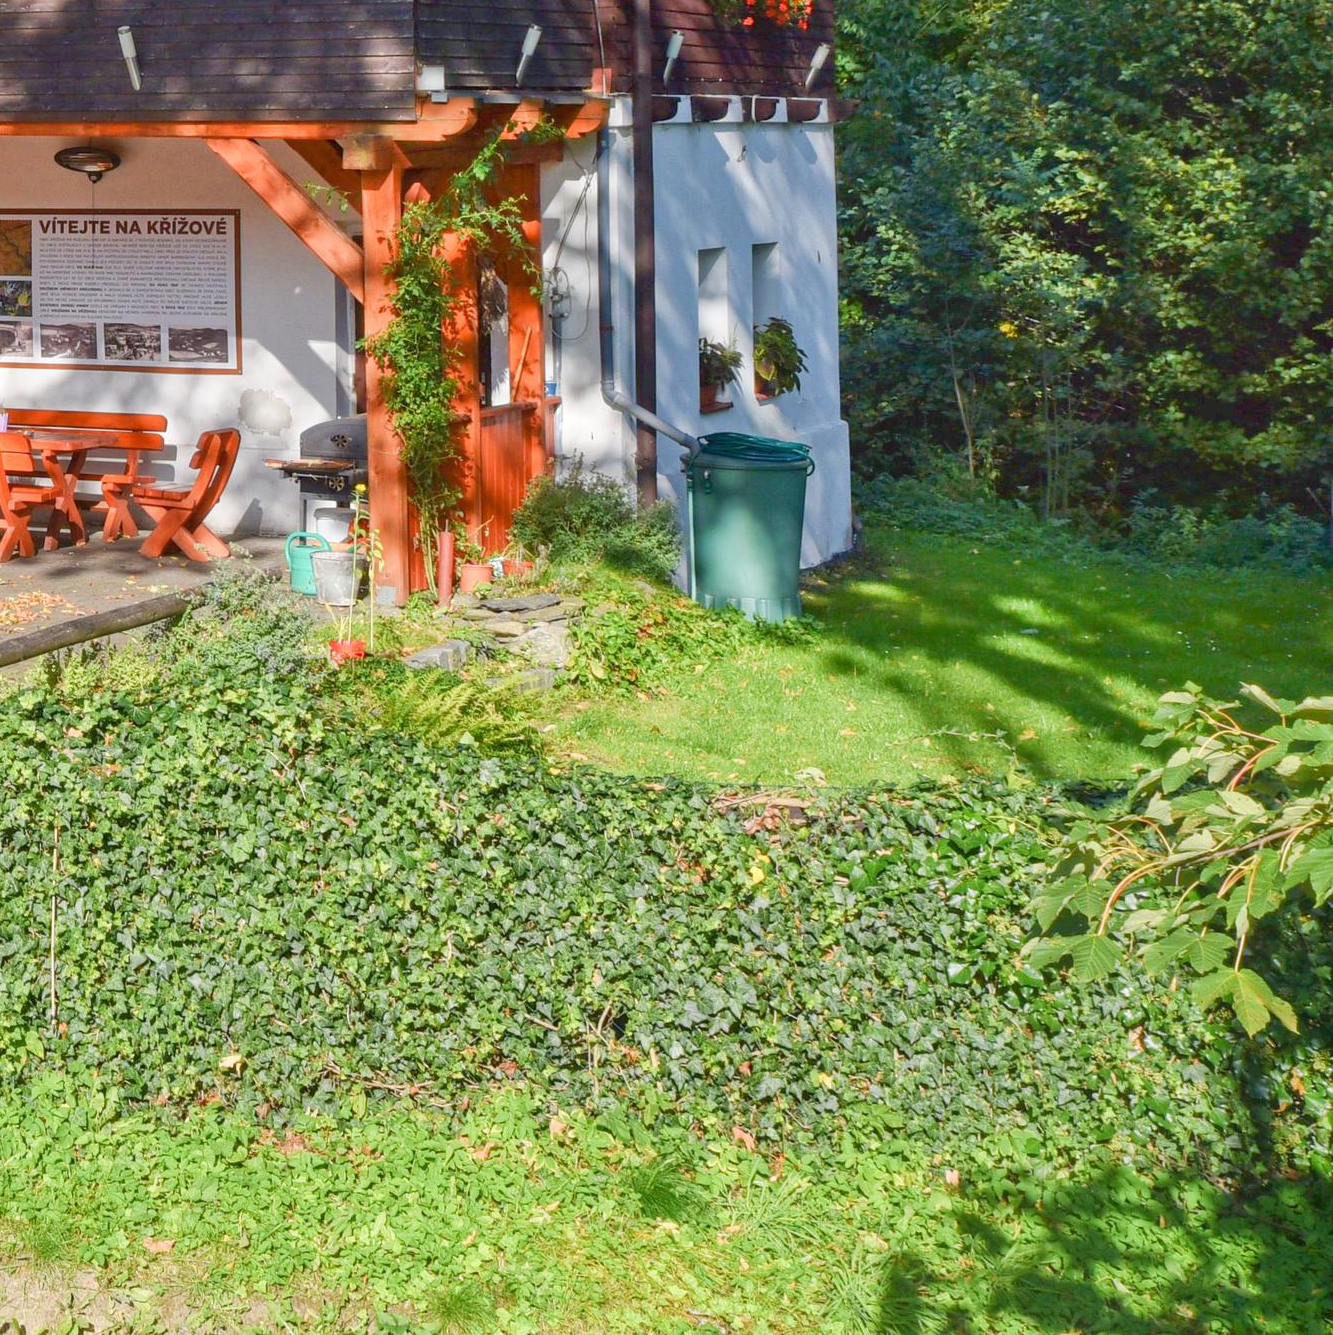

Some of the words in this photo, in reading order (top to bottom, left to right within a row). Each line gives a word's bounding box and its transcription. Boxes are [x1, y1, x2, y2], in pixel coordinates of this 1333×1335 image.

[39, 216, 110, 234] VÍTEJTE
[115, 220, 142, 235] NA
[147, 217, 227, 235] KŘÍŽOVÉ
